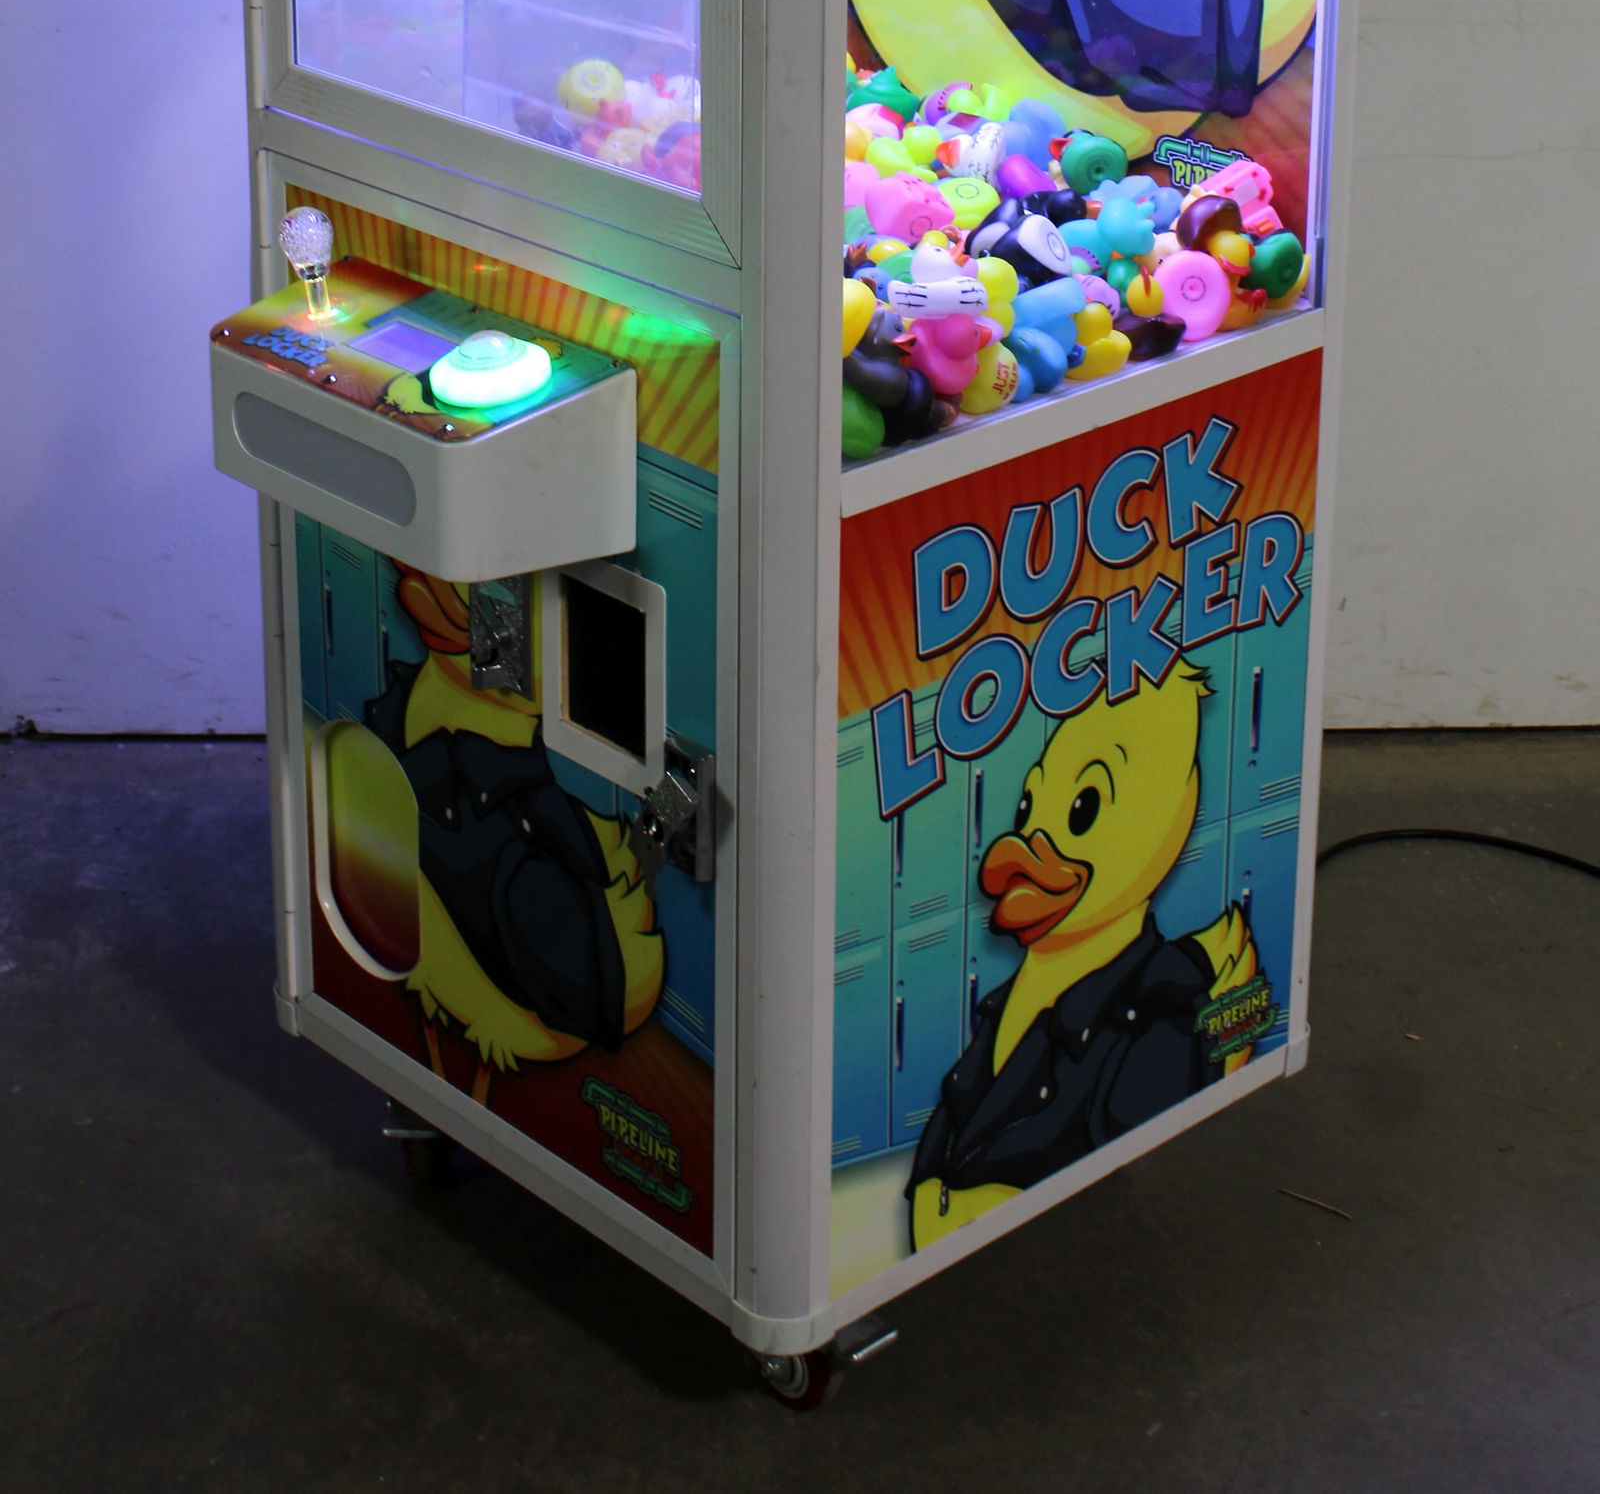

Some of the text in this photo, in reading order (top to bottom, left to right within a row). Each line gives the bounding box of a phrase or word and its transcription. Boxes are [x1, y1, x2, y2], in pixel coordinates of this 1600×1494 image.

[242, 332, 328, 367] LOCKER
[912, 415, 1243, 661] DUCK
[871, 512, 1303, 821] LOCKER
[1207, 988, 1270, 1035] PIPELINE
[600, 1104, 677, 1173] PIPELINE
